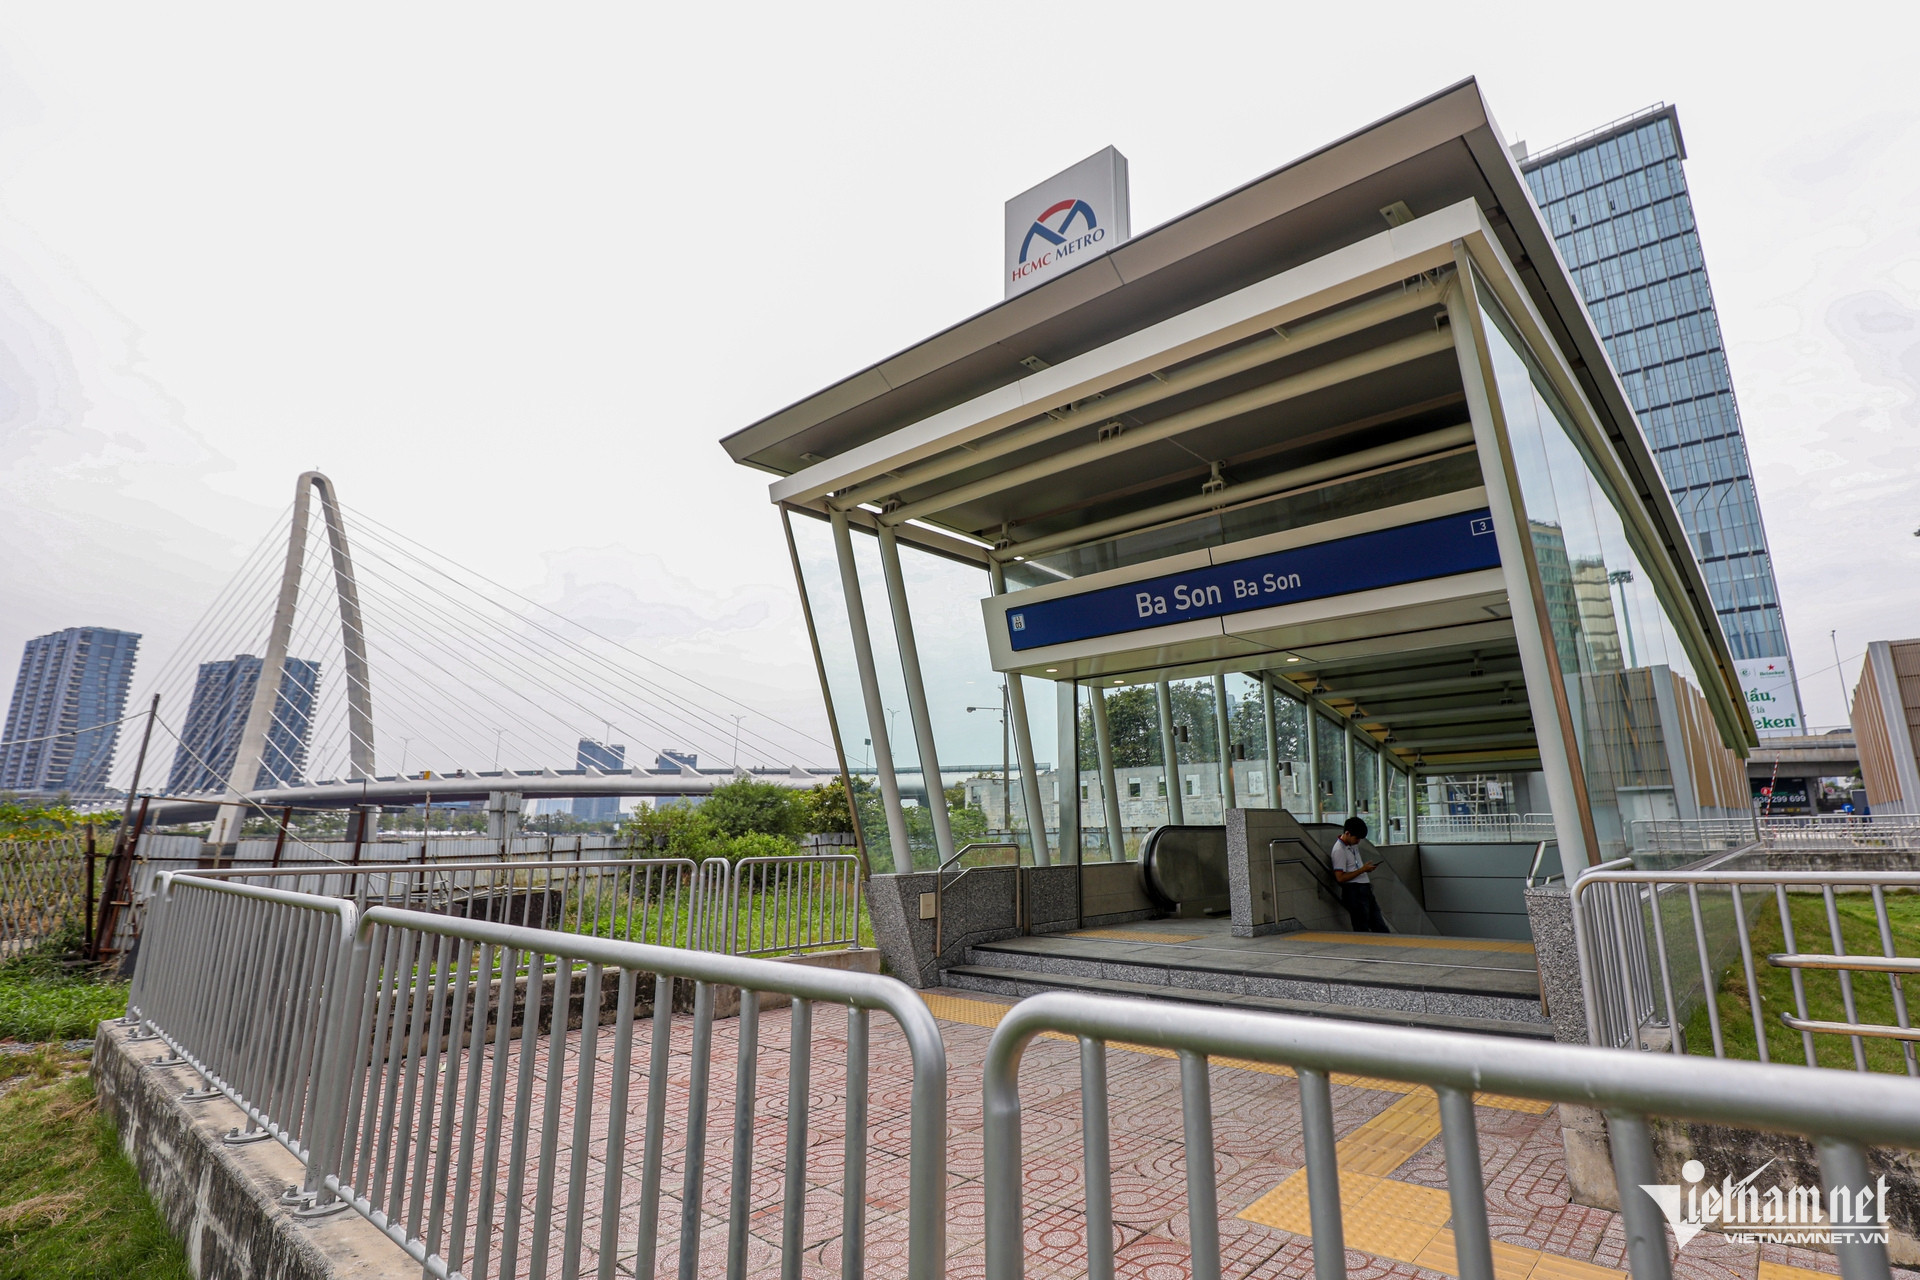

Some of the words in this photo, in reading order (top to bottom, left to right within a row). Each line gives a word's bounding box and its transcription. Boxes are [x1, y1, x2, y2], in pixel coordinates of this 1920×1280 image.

[1012, 252, 1052, 282] HCMC
[1055, 228, 1105, 260] METRO
[1480, 521, 1487, 531] 3
[1233, 579, 1259, 599] Ba
[1262, 573, 1302, 593] Son
[1135, 592, 1168, 618] Ba
[1173, 584, 1222, 611] Son
[1754, 716, 1796, 729] eken
[1772, 795, 1788, 803] 299
